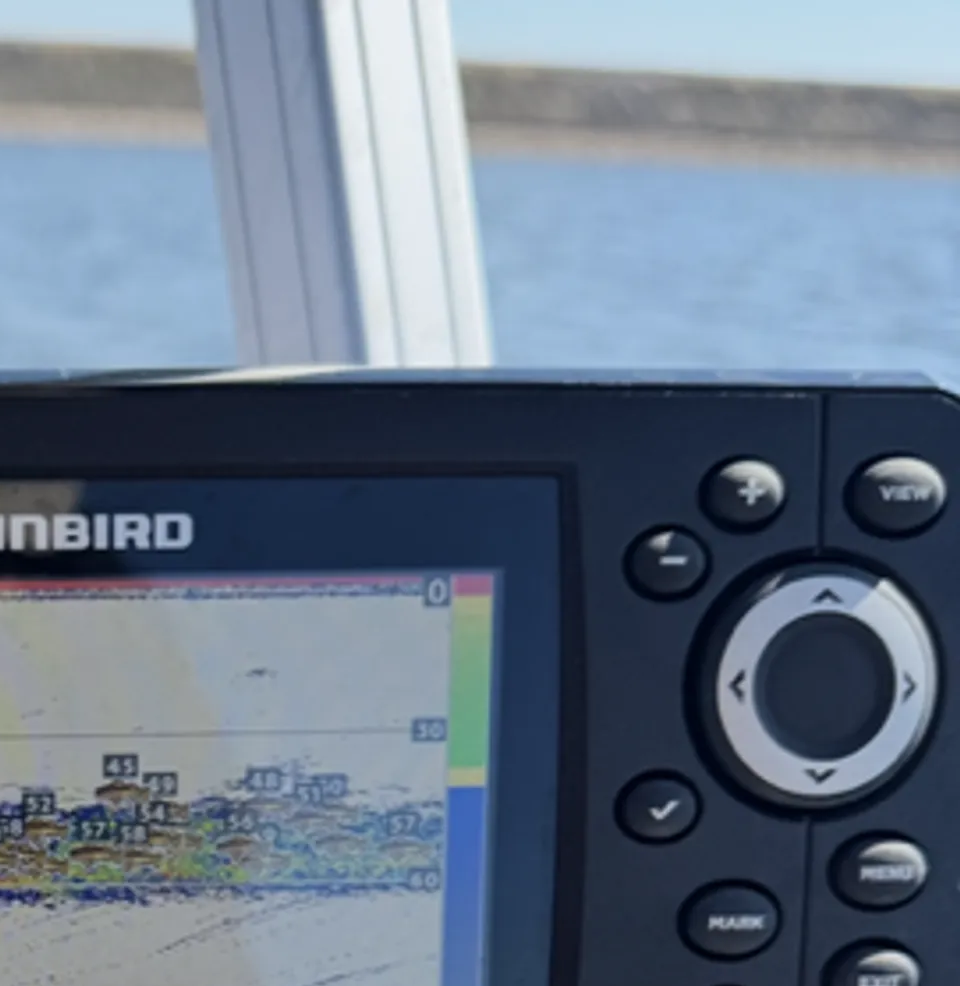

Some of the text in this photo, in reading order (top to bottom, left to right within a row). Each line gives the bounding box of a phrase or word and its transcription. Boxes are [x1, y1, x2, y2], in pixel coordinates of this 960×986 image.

[878, 484, 933, 501] VIEW
[428, 577, 447, 604] 0
[708, 914, 767, 931] MARK
